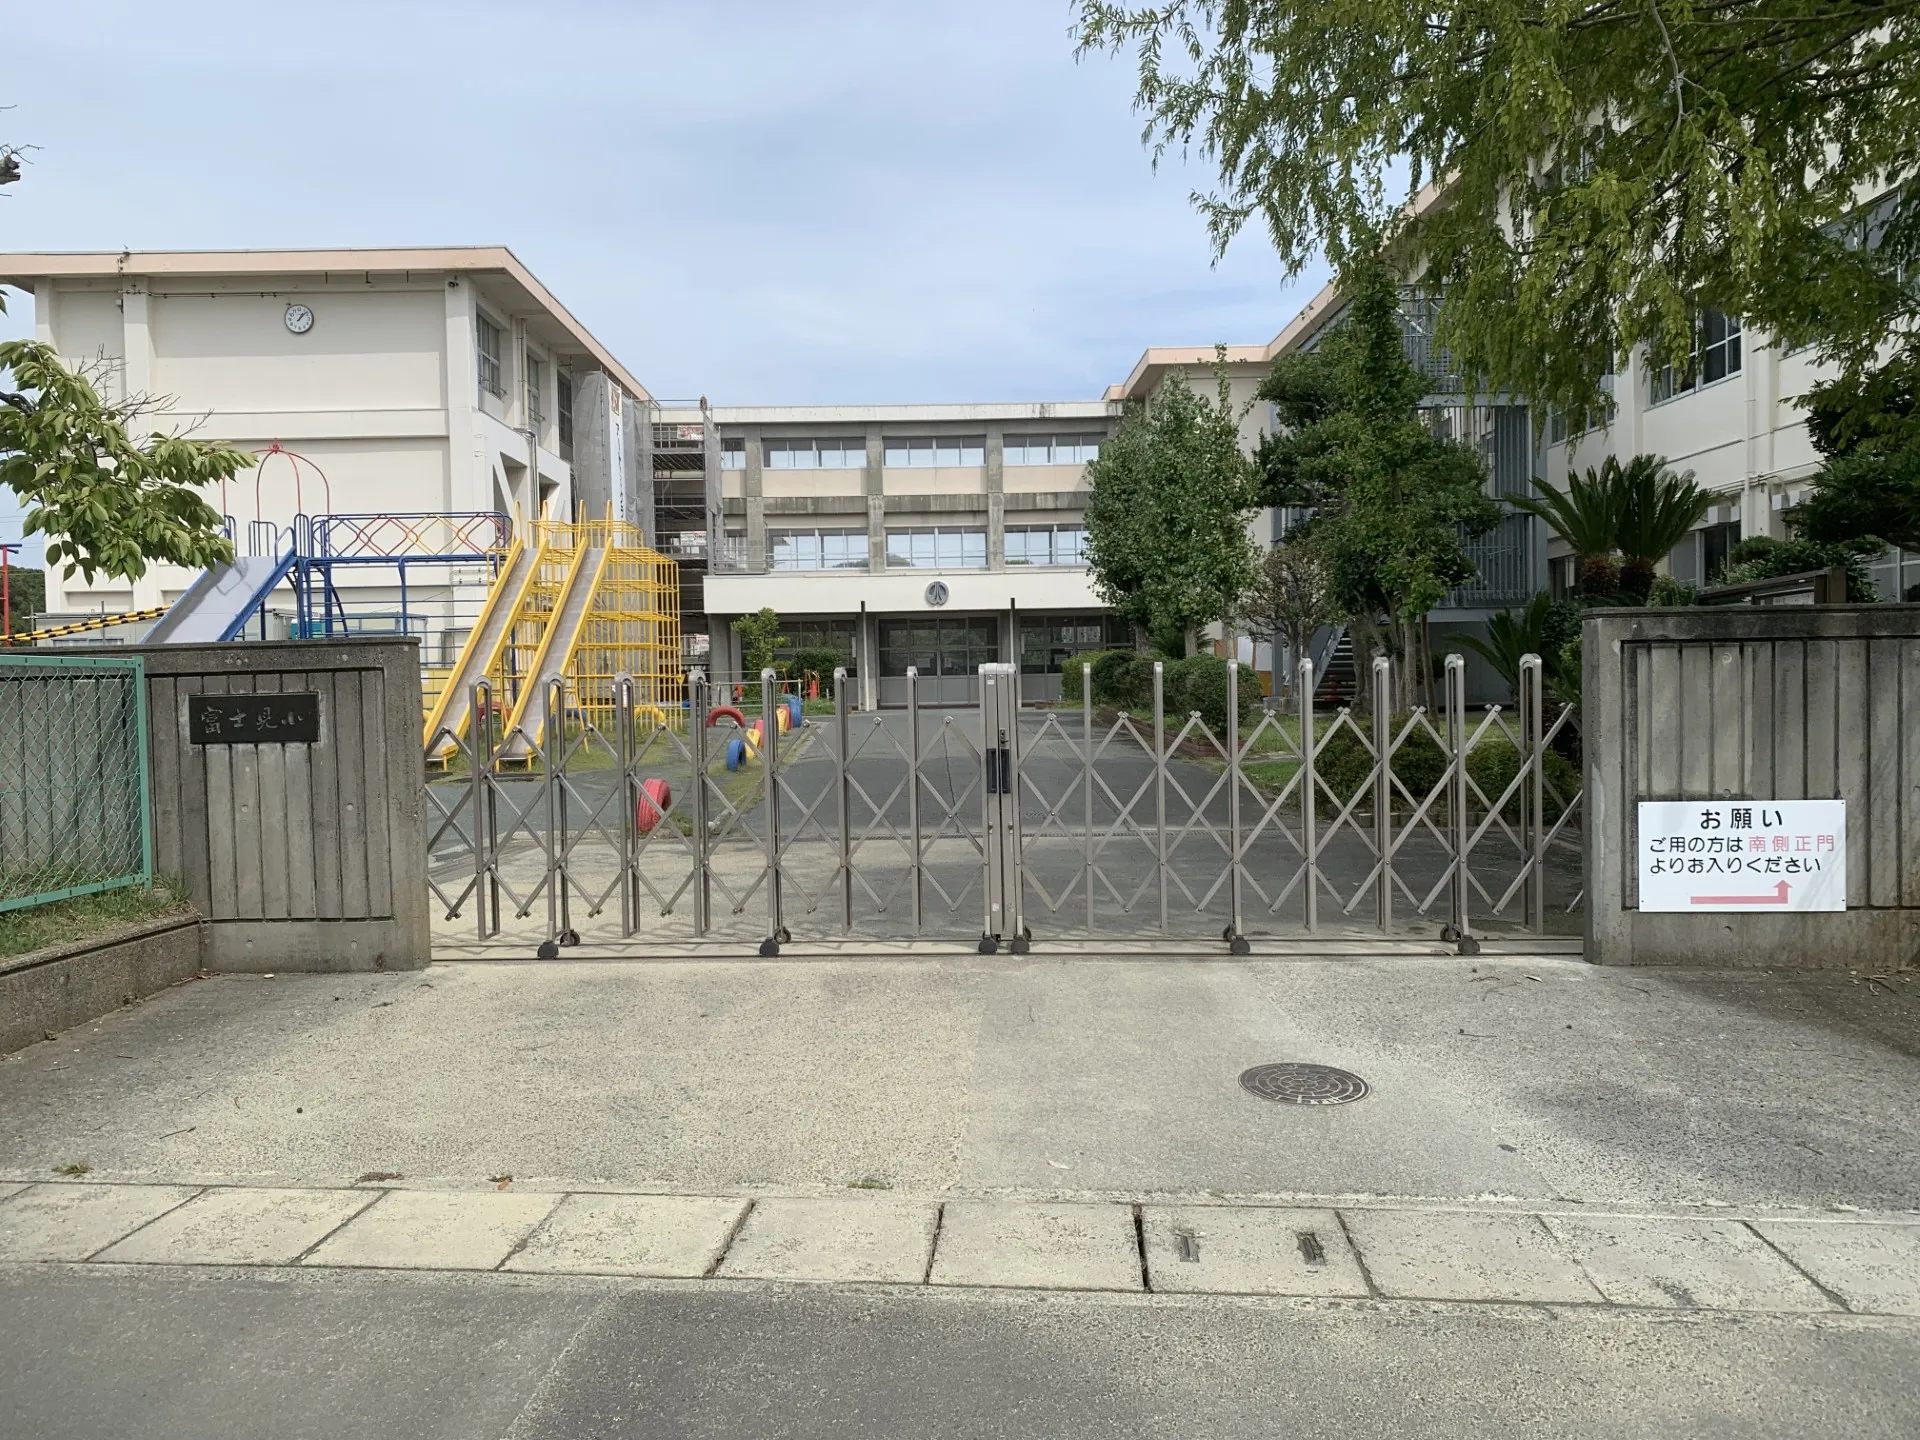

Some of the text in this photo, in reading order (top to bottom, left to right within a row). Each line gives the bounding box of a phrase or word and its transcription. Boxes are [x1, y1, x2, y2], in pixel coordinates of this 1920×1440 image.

[201, 704, 303, 734] 富士見小
[1700, 808, 1783, 829] お願い
[1650, 856, 1821, 874] よりお入りください
